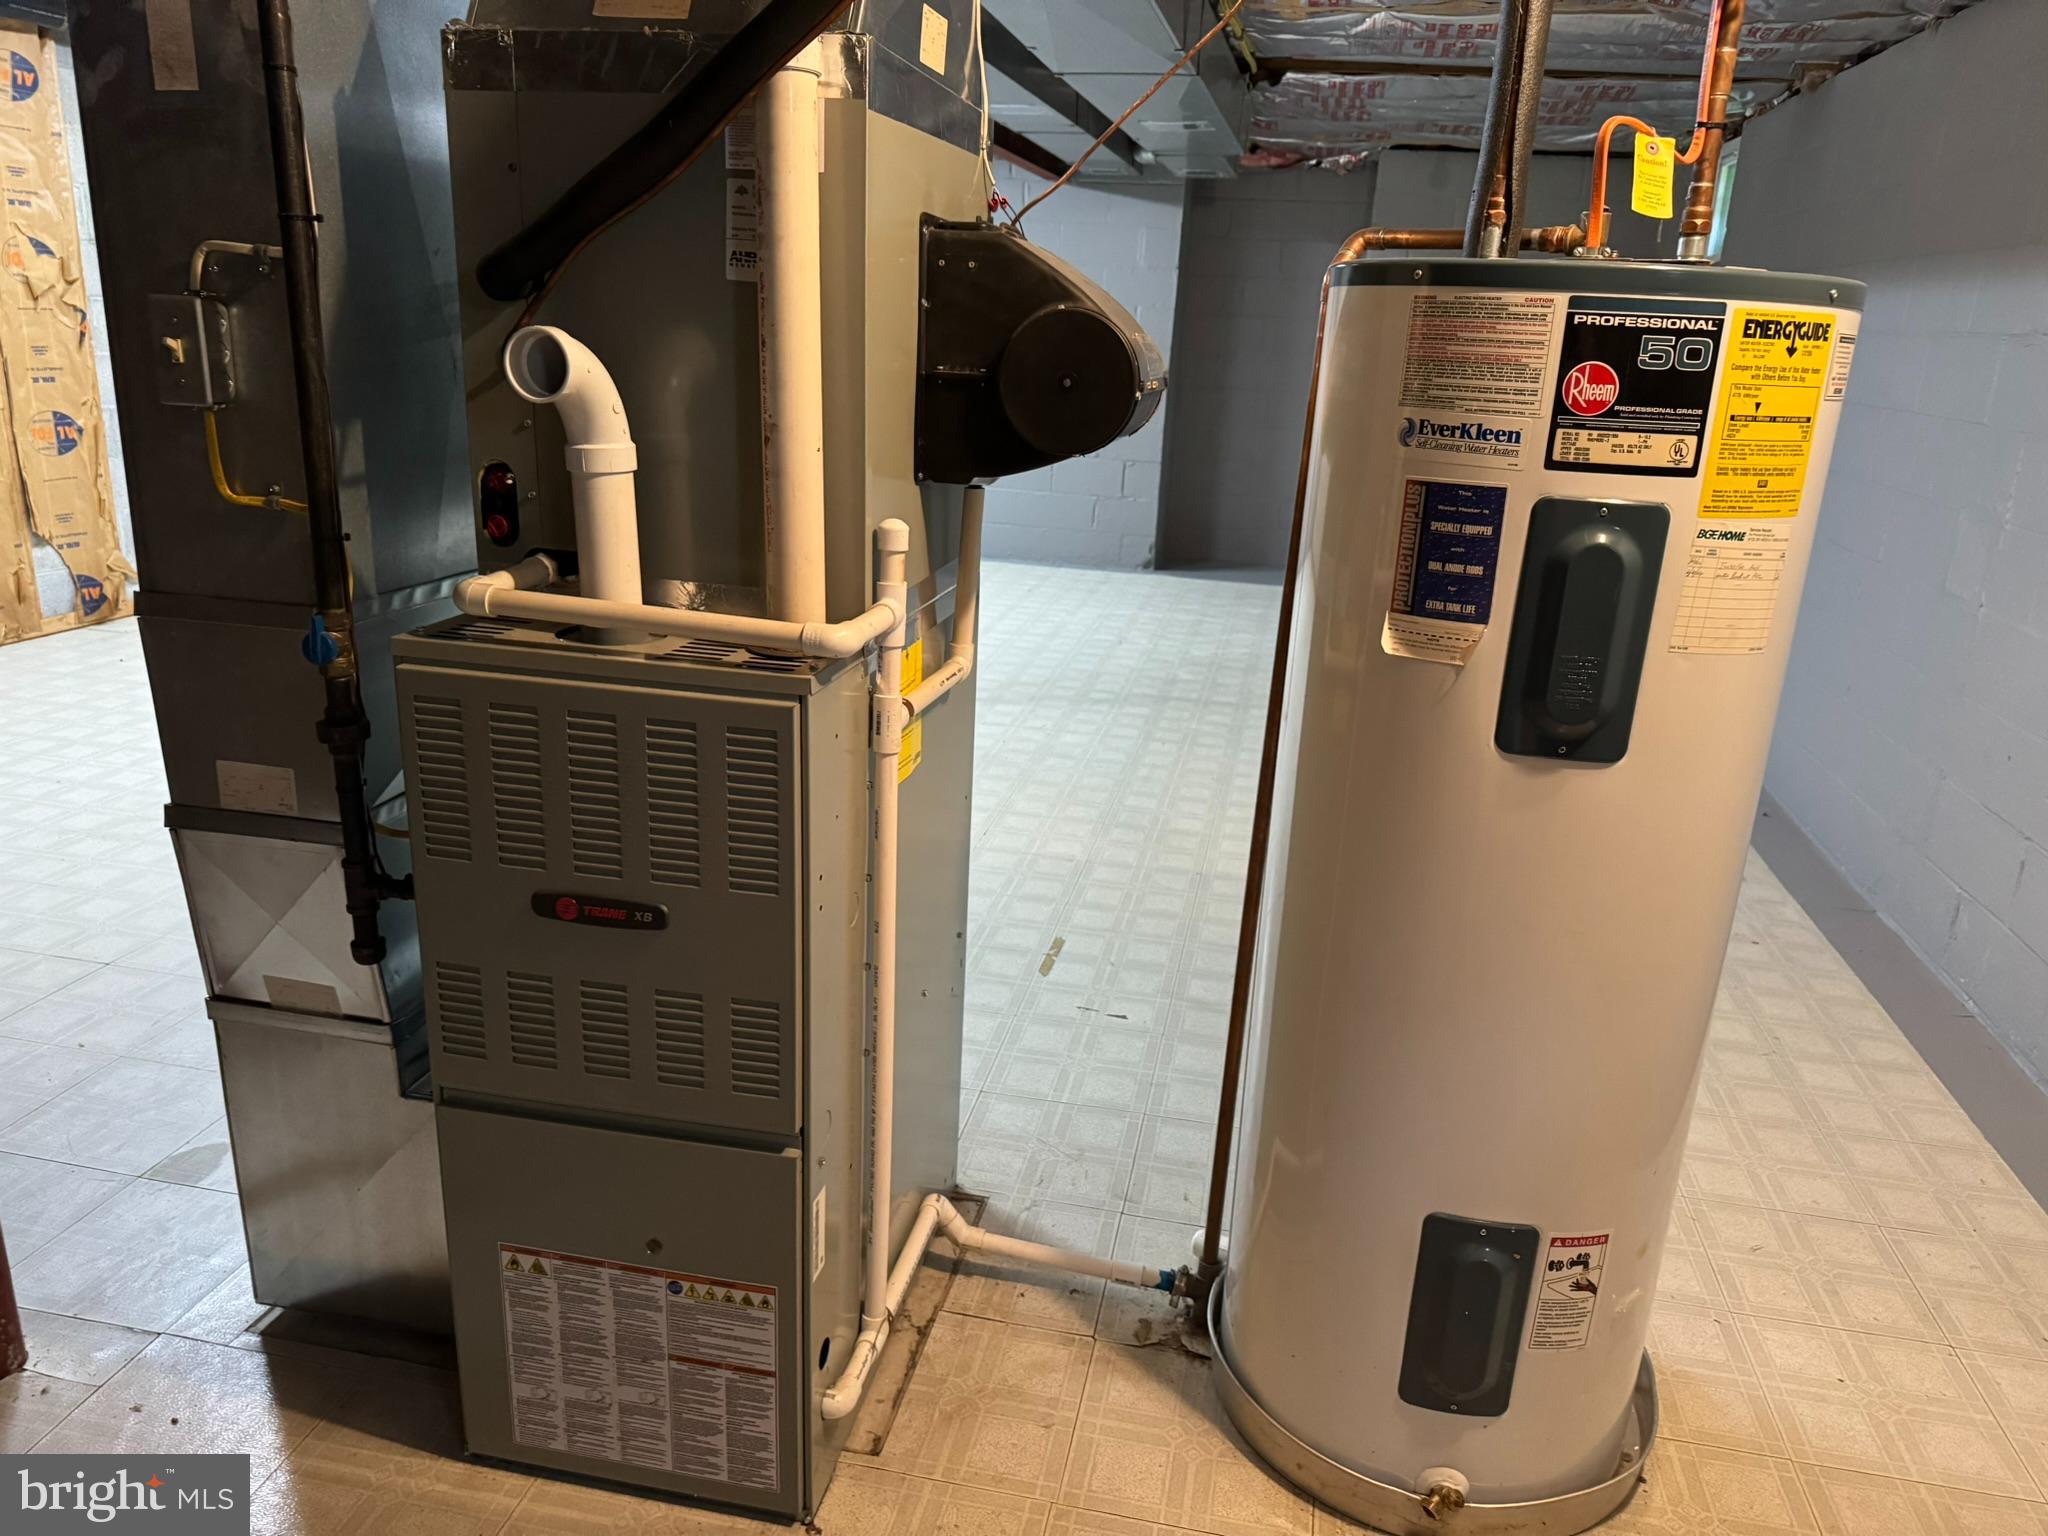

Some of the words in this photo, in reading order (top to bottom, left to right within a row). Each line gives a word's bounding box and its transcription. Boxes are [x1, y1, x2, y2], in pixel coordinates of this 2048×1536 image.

[1573, 314, 1718, 331] PROFESSIONAL
[1637, 335, 1714, 372] 50
[1731, 363, 1753, 372] Compare
[1763, 365, 1778, 373] Energy
[1568, 364, 1615, 408] Rheem
[1614, 405, 1675, 414] PROFESSIONAL
[1418, 418, 1522, 444] EverKleen
[1415, 439, 1462, 453] Self-Cleaning
[1464, 443, 1487, 454] Water
[1488, 445, 1519, 457] Heaters
[1430, 521, 1460, 532] SPECIALLY
[1461, 524, 1493, 537] EQUIPPED
[1718, 531, 1747, 542] HOME
[1428, 560, 1443, 571] DUAL
[1444, 562, 1464, 574] ANODE
[1466, 565, 1484, 576] RODS
[1425, 600, 1445, 611] EXTRA
[1446, 602, 1461, 612] TANK
[1462, 604, 1476, 614] LIFE
[583, 905, 628, 920] TRANE
[1565, 1237, 1606, 1246] DANGER
